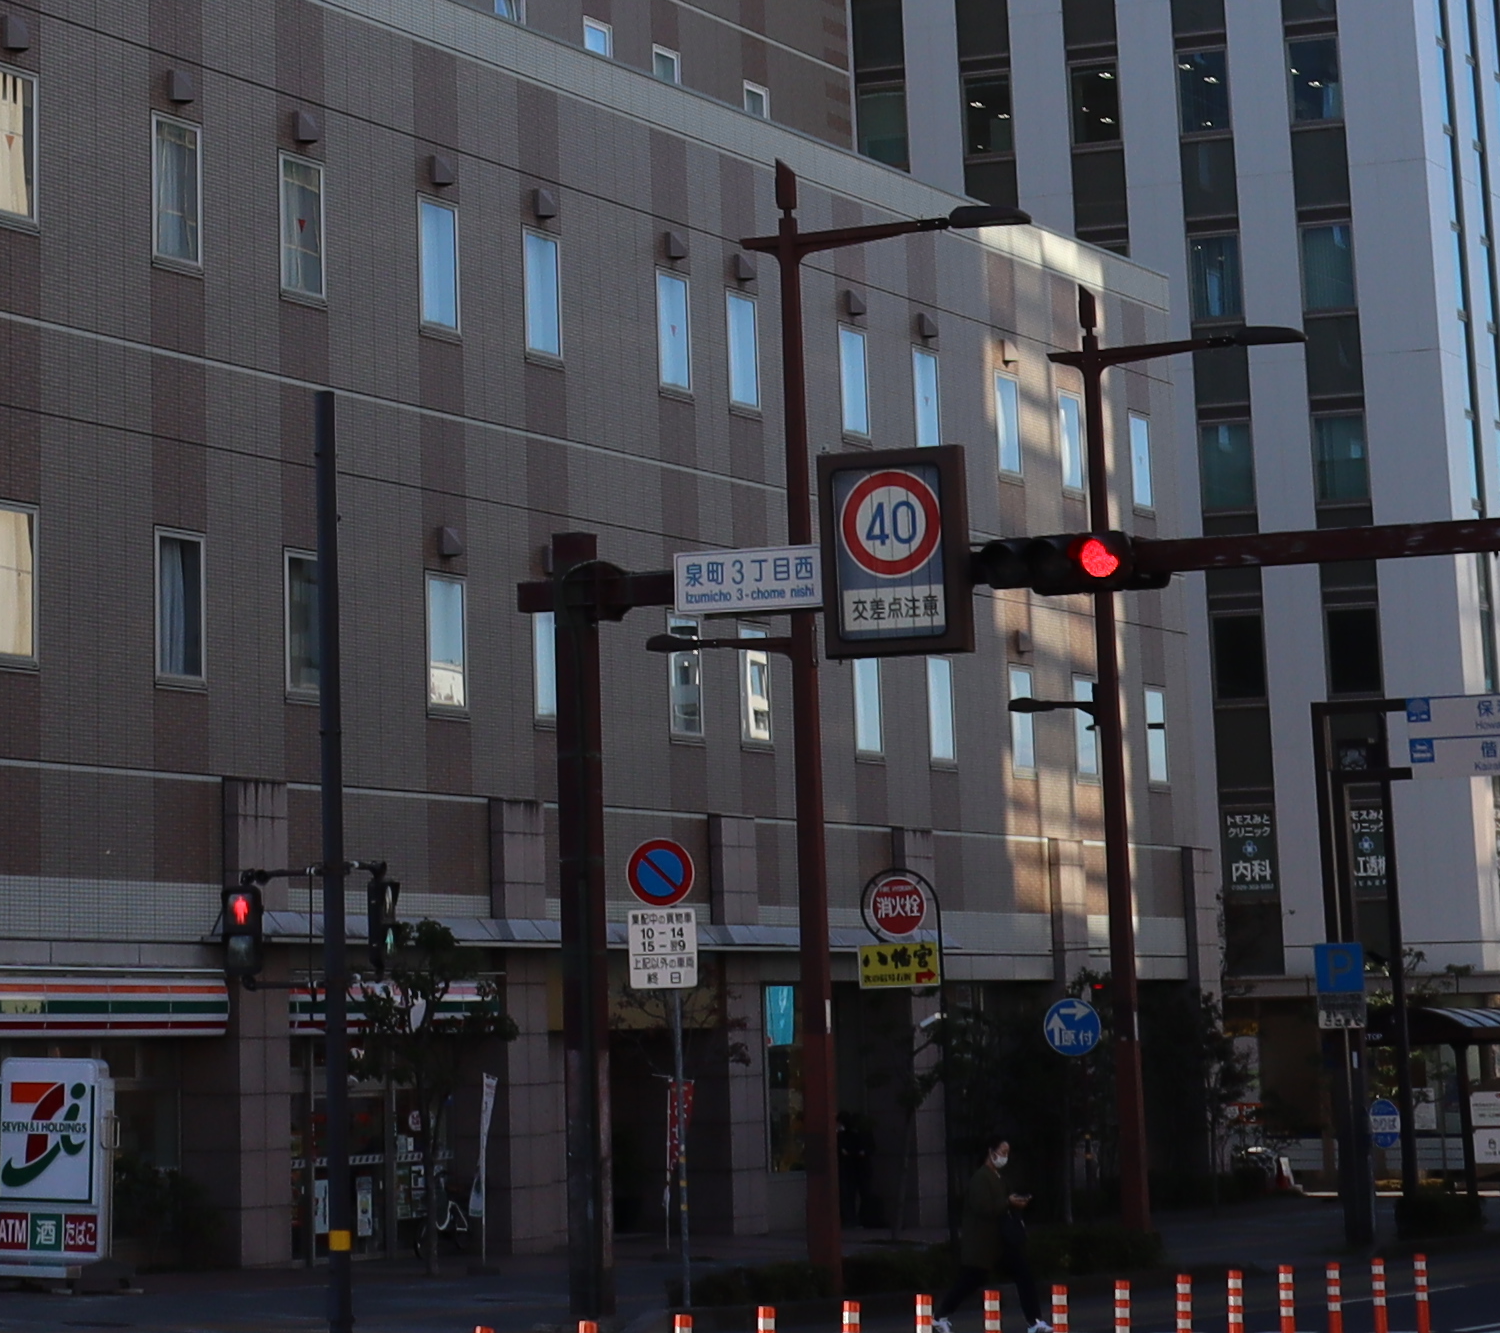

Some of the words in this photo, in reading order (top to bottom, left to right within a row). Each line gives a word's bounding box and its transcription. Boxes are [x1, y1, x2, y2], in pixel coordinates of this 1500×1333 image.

[866, 501, 917, 546] 40
[685, 557, 813, 587] 泉町3丁目西
[685, 589, 732, 604] Izumicho
[790, 583, 814, 598] nishi
[852, 595, 939, 622] 交差点注意
[1227, 814, 1271, 825] トモスみと
[1228, 827, 1271, 838] クリニック
[1231, 859, 1272, 882] 内科
[876, 894, 921, 919] 消火栓
[634, 956, 694, 970] 上記以外の車両
[1328, 949, 1354, 987] P
[1061, 1029, 1094, 1046] 原付
[41, 1121, 87, 1133] HOLDINGS
[36, 1219, 57, 1245] 酒
[65, 1220, 96, 1246] たばこ
